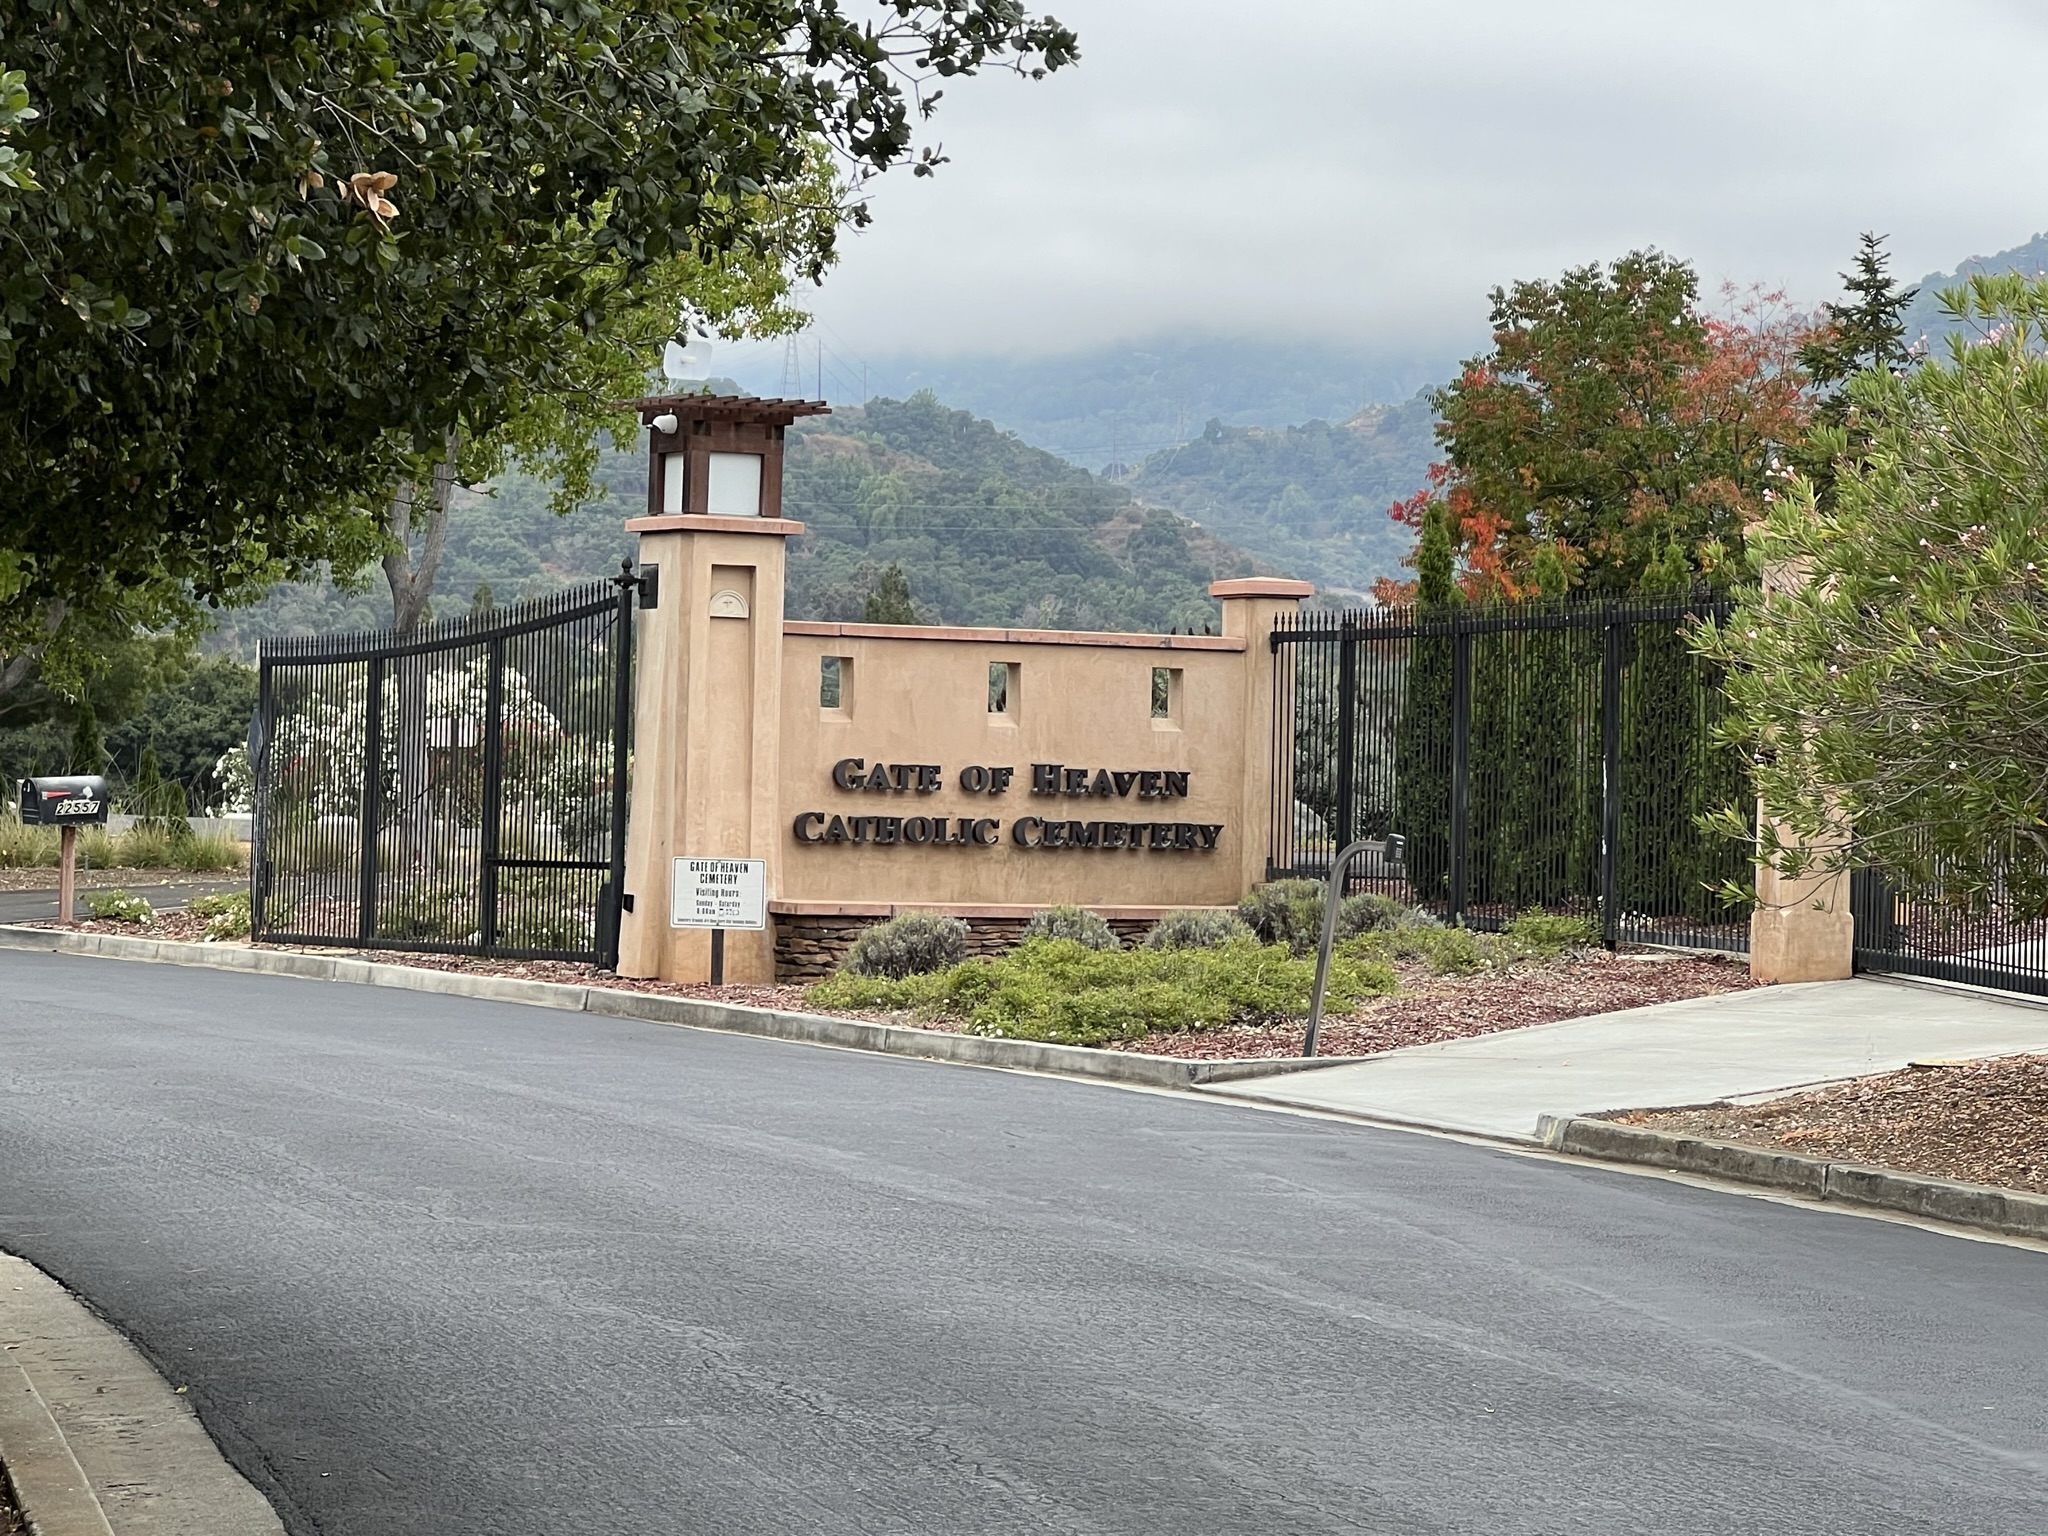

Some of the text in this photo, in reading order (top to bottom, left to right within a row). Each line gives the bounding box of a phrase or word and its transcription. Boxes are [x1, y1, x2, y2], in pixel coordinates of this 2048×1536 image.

[833, 758, 1191, 797] GATE OF HEAVEN
[57, 802, 98, 814] 22557
[793, 812, 1224, 849] CATHOLIC CEMETERY
[690, 861, 749, 873] GATE OF HEAVEN
[700, 874, 738, 884] CEMETERY
